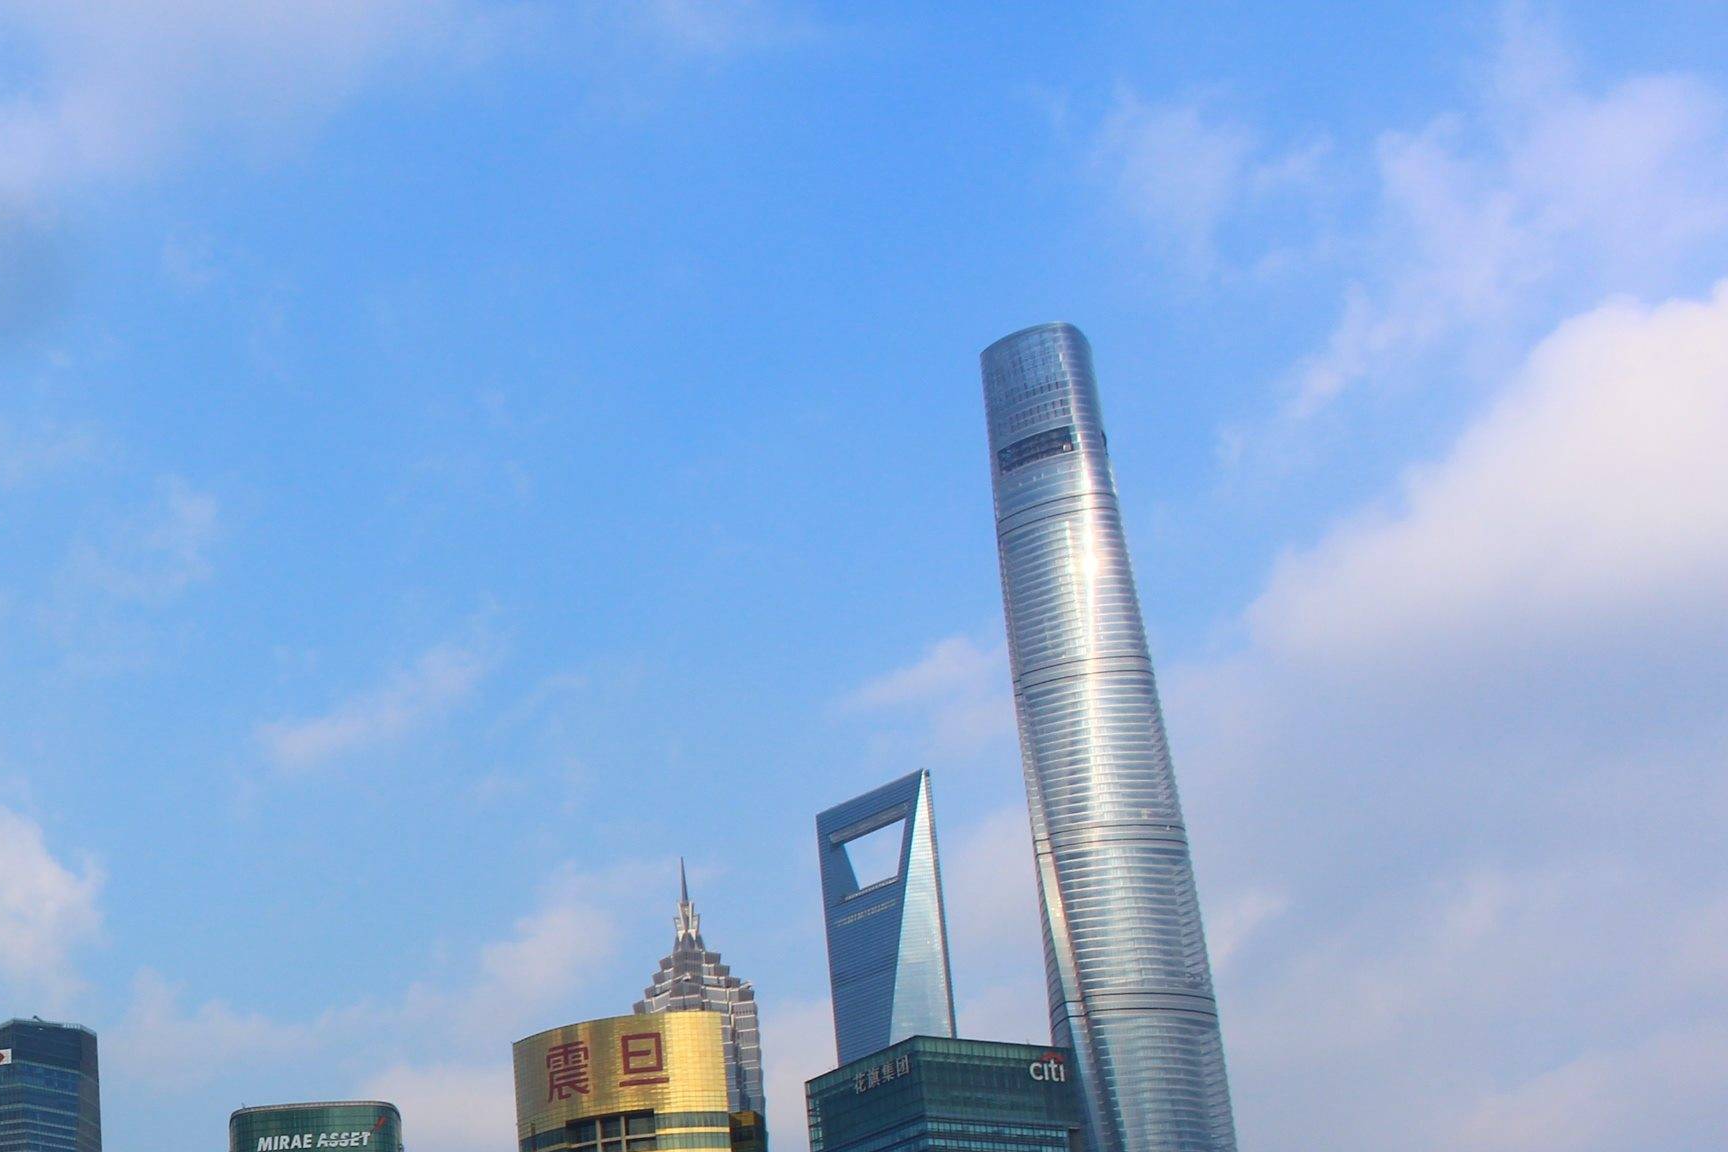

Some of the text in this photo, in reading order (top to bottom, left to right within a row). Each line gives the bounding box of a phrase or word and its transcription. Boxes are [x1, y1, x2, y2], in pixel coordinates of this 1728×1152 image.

[545, 1032, 670, 1103] 震旦
[853, 1054, 910, 1095] 花旗集团
[1029, 1058, 1066, 1082] citi
[257, 1131, 371, 1152] MIRAE ASSET
